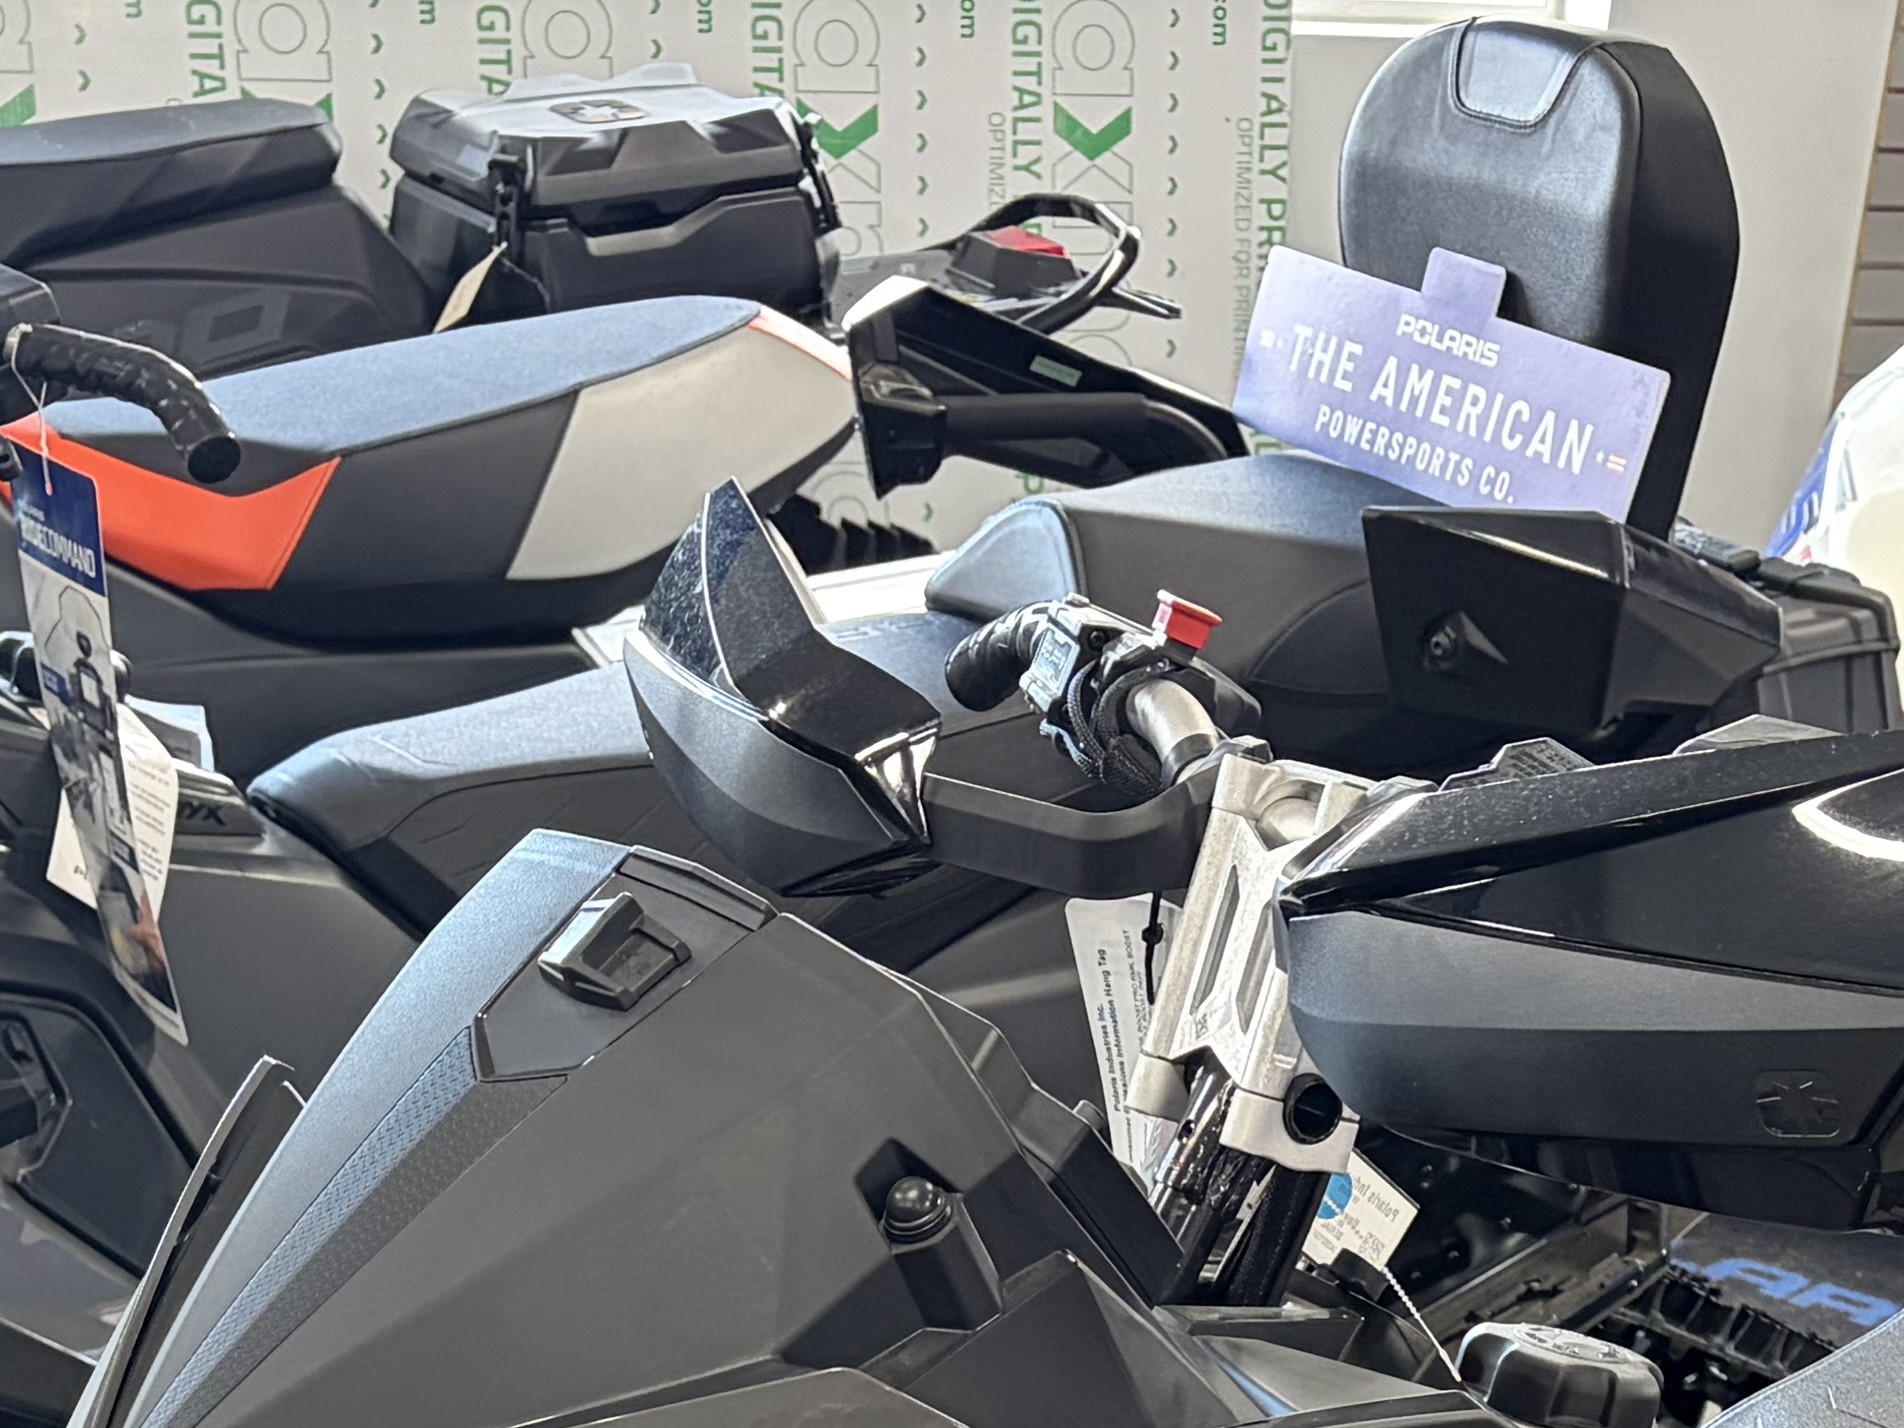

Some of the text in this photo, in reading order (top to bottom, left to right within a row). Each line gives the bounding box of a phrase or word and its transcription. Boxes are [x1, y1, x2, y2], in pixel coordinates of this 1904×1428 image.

[1396, 312, 1501, 368] POLARIS
[1286, 322, 1594, 477] THE AMERICAN
[1312, 403, 1516, 506] POWERSPORTS CO.
